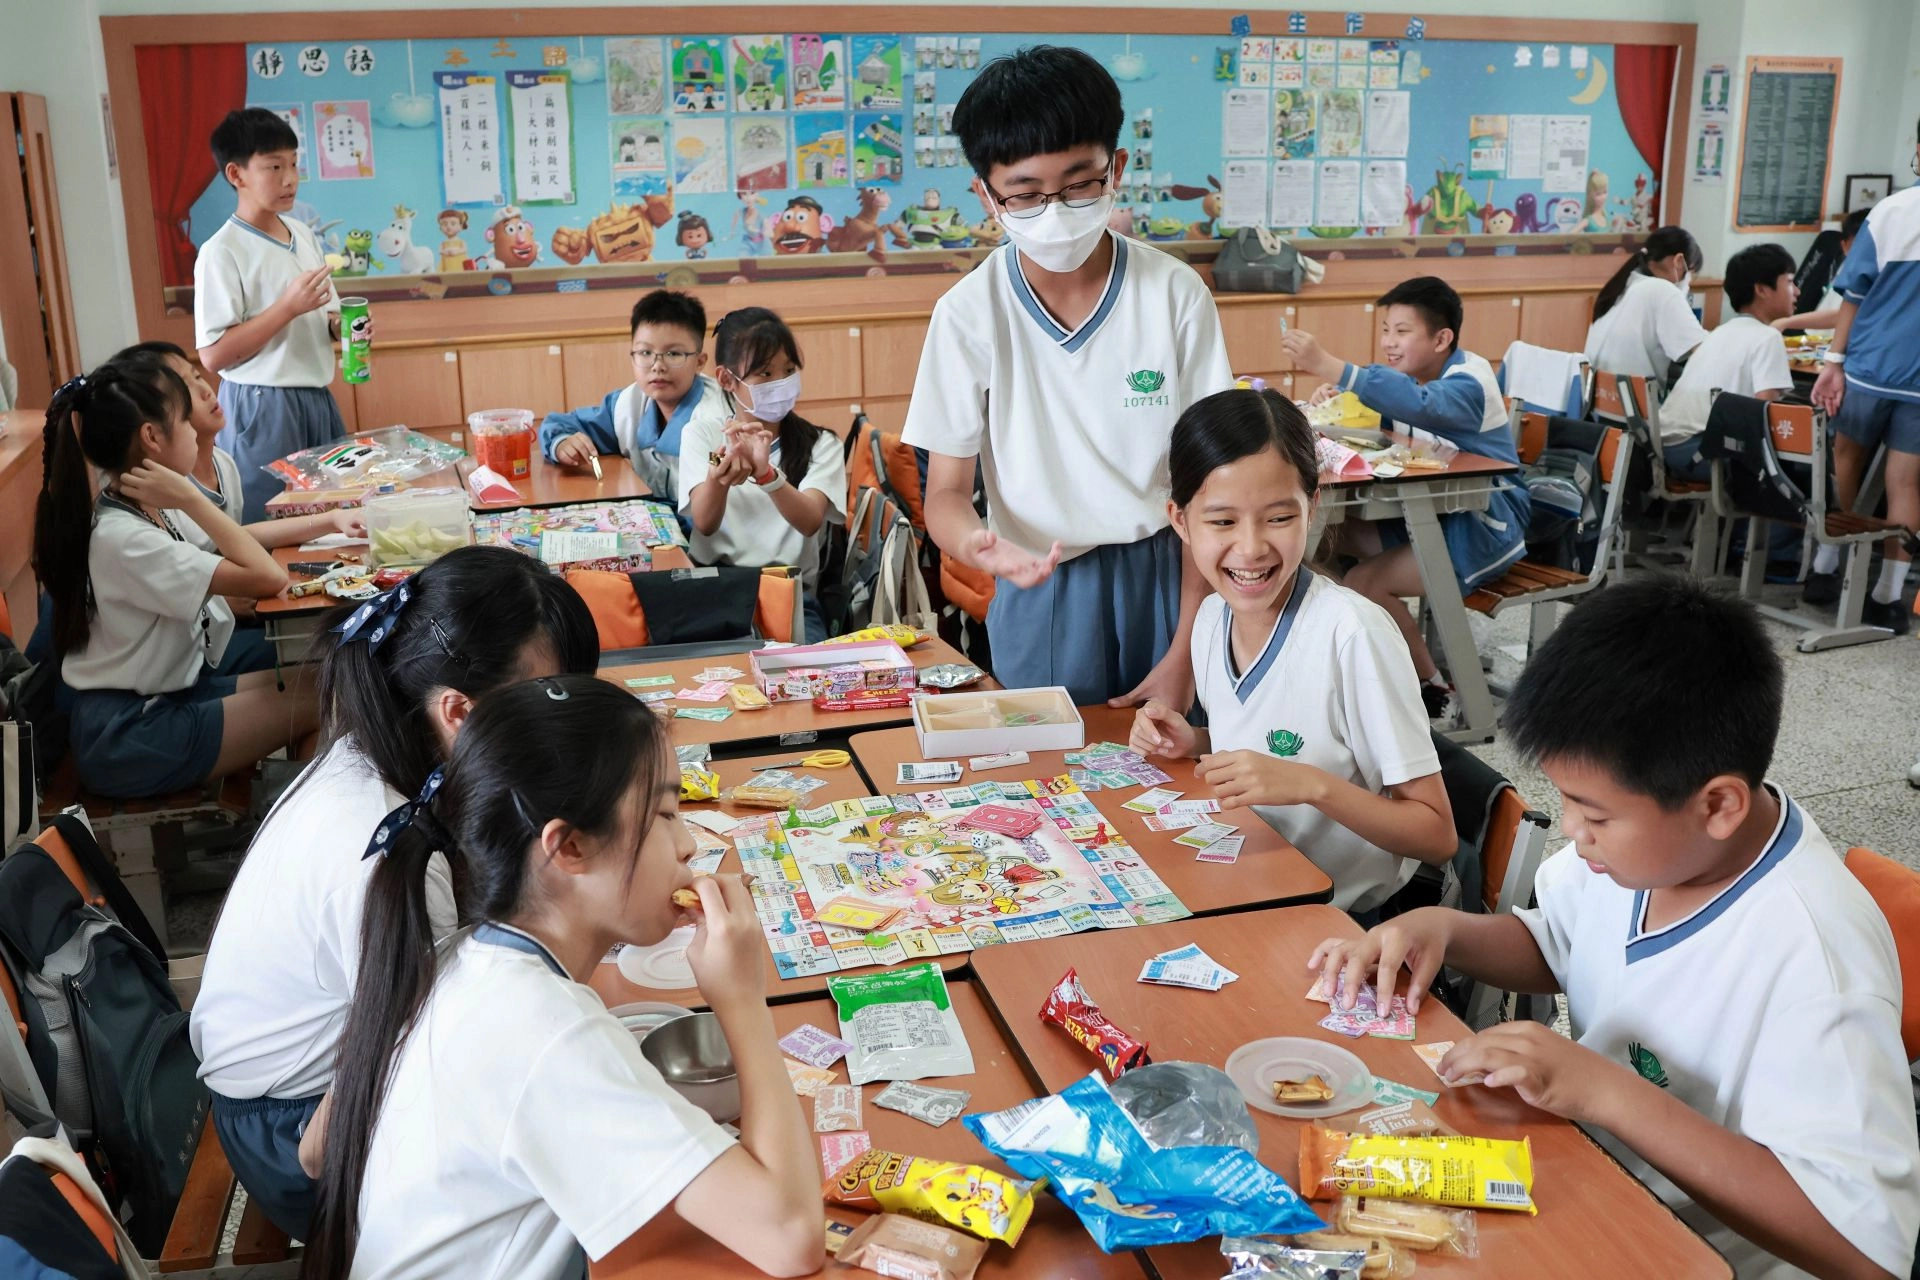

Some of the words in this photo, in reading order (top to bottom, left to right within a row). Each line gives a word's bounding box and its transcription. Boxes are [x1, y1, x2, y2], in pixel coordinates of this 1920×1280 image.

[254, 48, 374, 75] 靜思語
[1123, 395, 1169, 408] 107141
